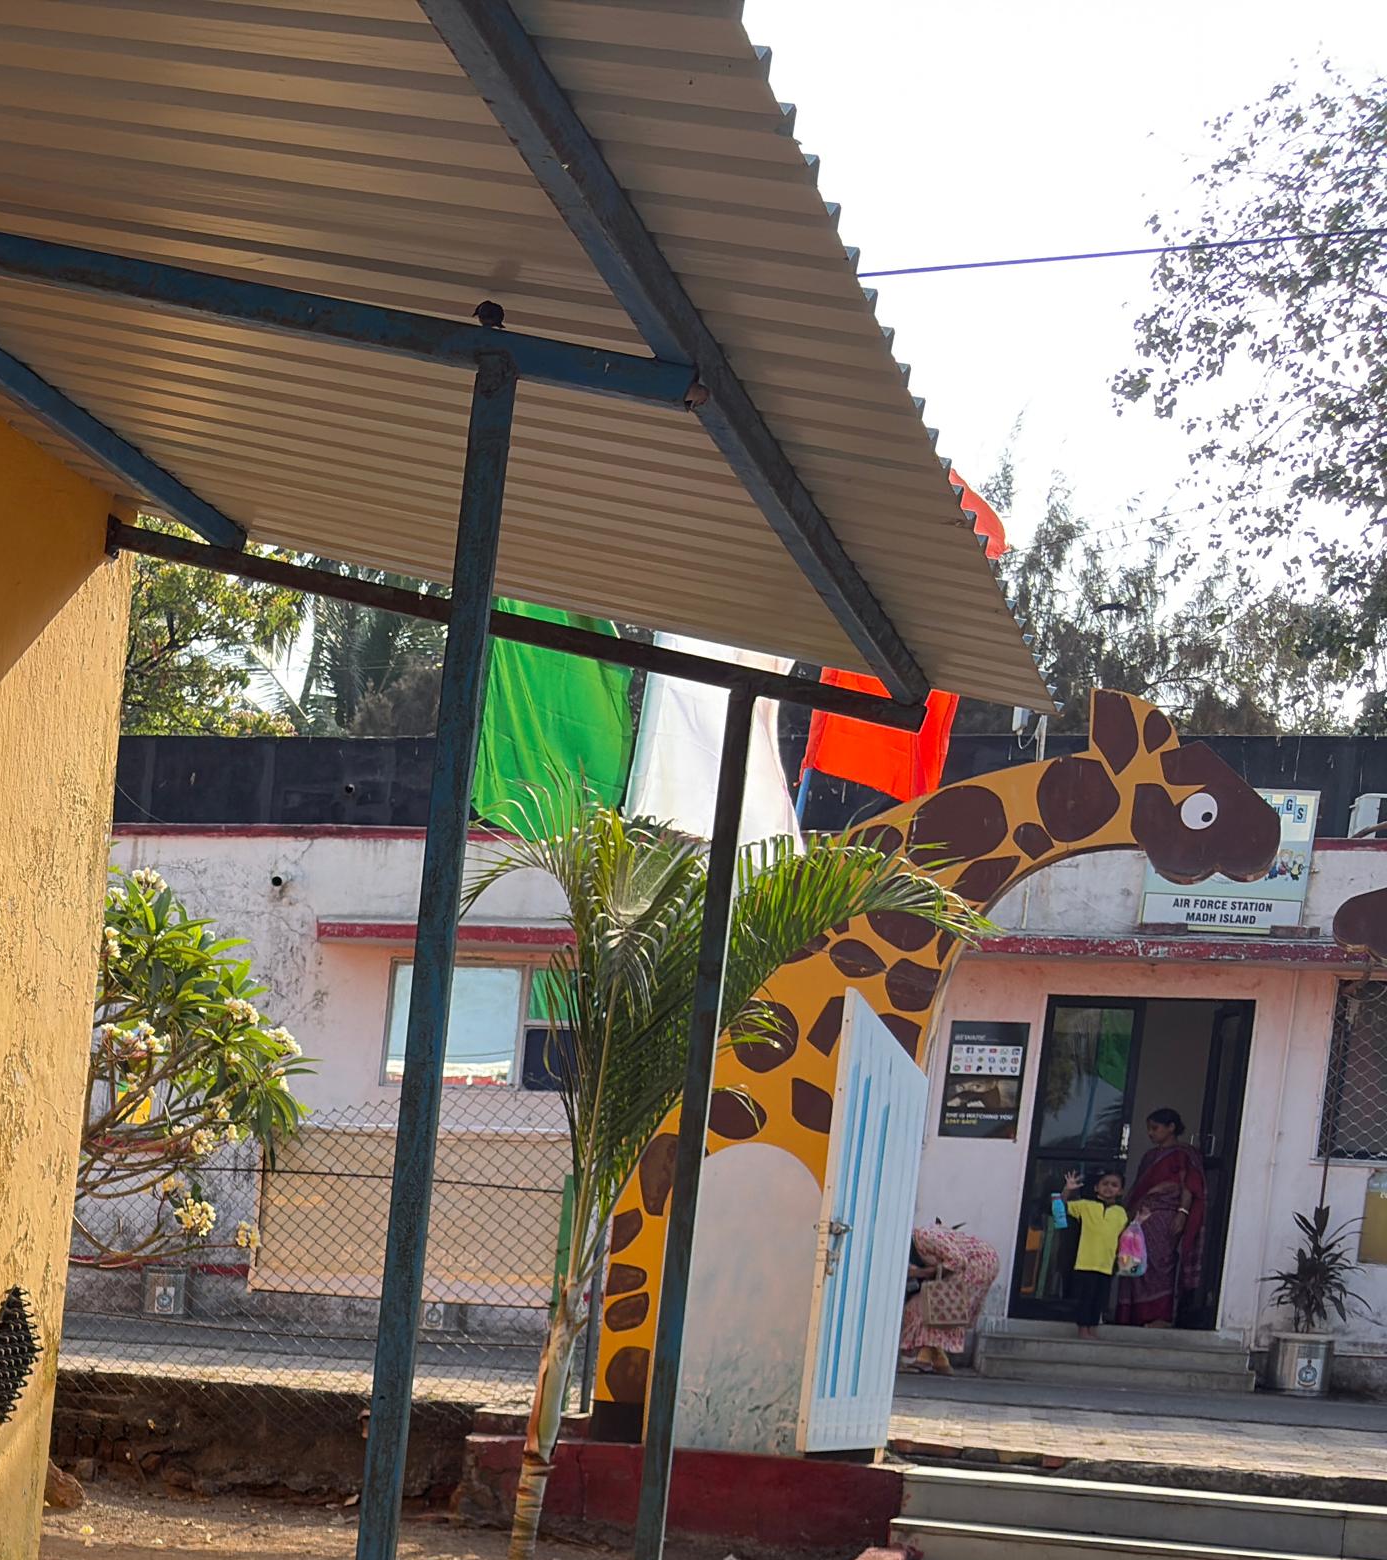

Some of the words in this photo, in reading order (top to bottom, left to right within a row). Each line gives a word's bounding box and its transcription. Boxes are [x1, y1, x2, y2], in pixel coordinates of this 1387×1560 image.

[1172, 898, 1190, 908] AIR
[1193, 899, 1227, 910] FORCE
[1230, 900, 1273, 912] STATION
[1185, 912, 1217, 922] MADH
[1219, 914, 1256, 924] ISLAND
